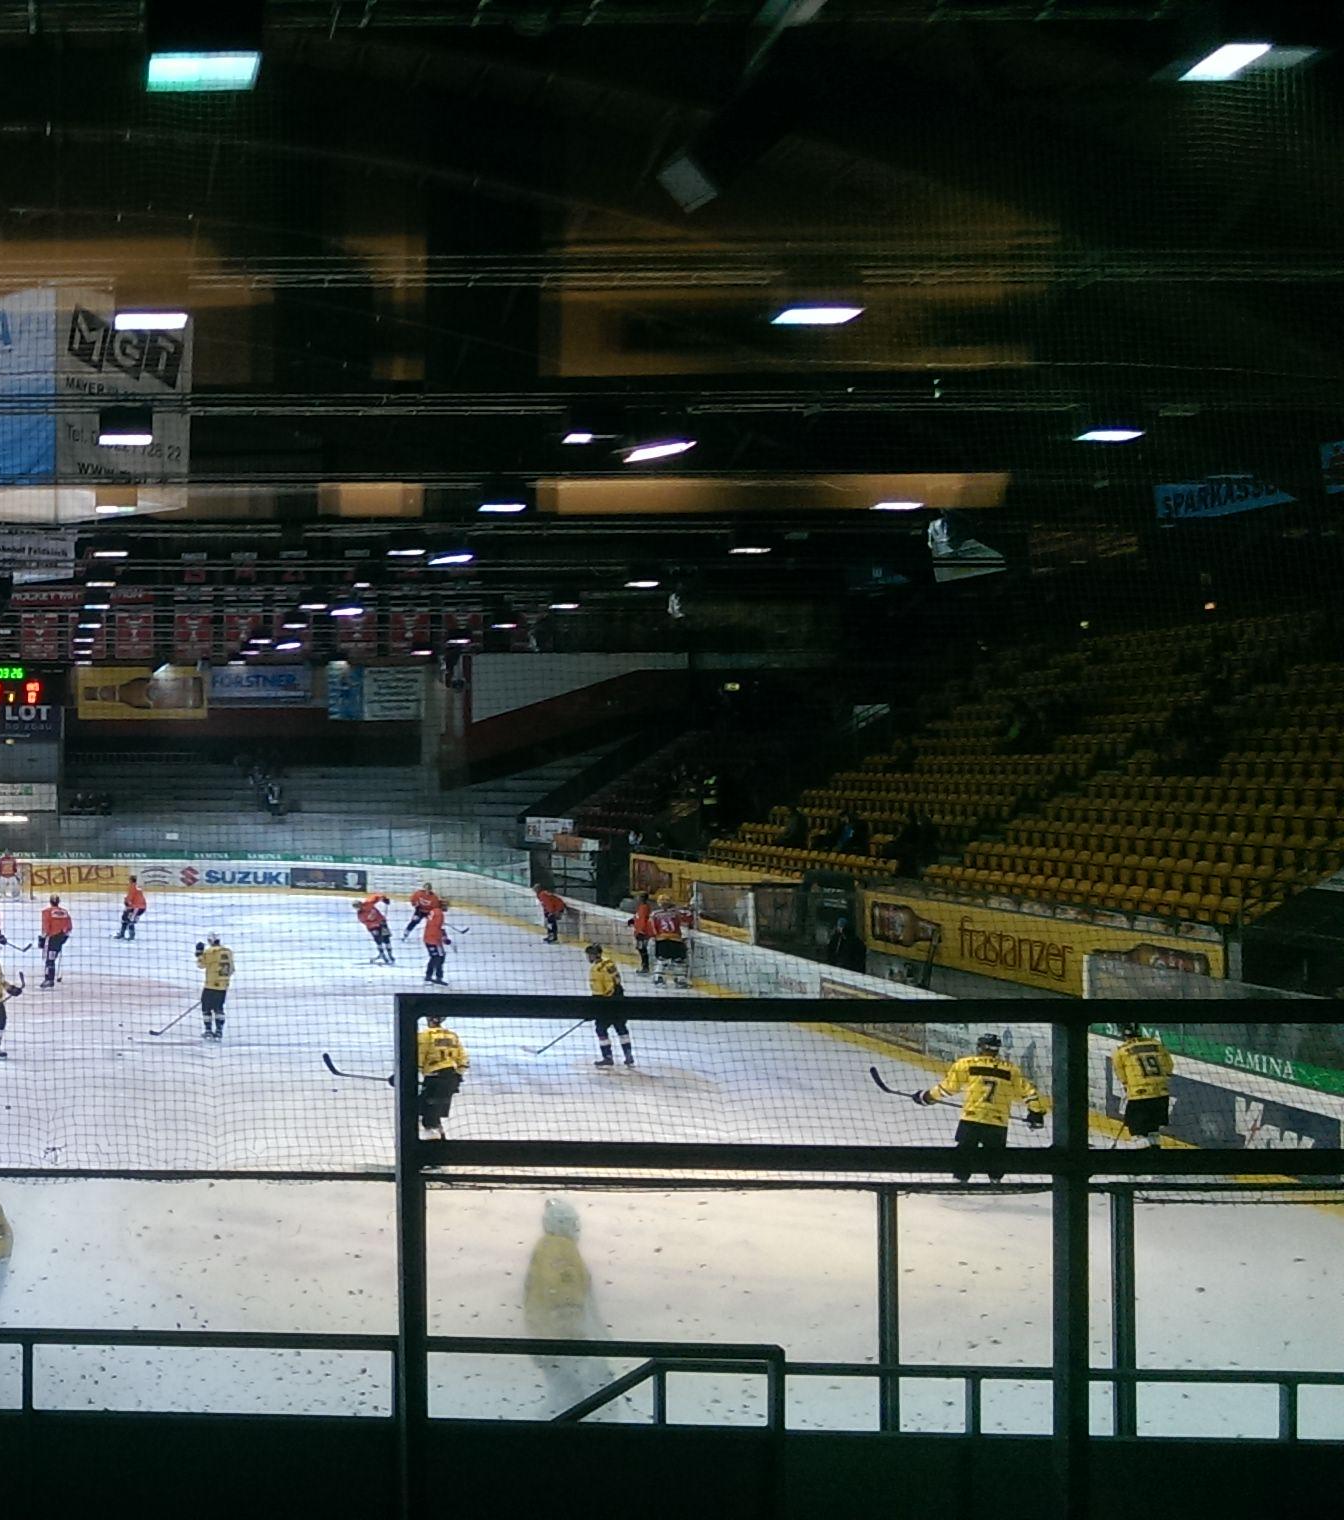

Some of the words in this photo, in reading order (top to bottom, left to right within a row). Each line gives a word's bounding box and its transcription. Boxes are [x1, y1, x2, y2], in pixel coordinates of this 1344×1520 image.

[65, 377, 104, 396] MAYER
[5, 705, 52, 722] LOT
[205, 868, 291, 886] SUZUKI
[958, 915, 1074, 982] frastanzer
[1138, 1055, 1161, 1077] 19
[1224, 1046, 1296, 1081] SAMINA
[983, 1079, 997, 1103] 7
